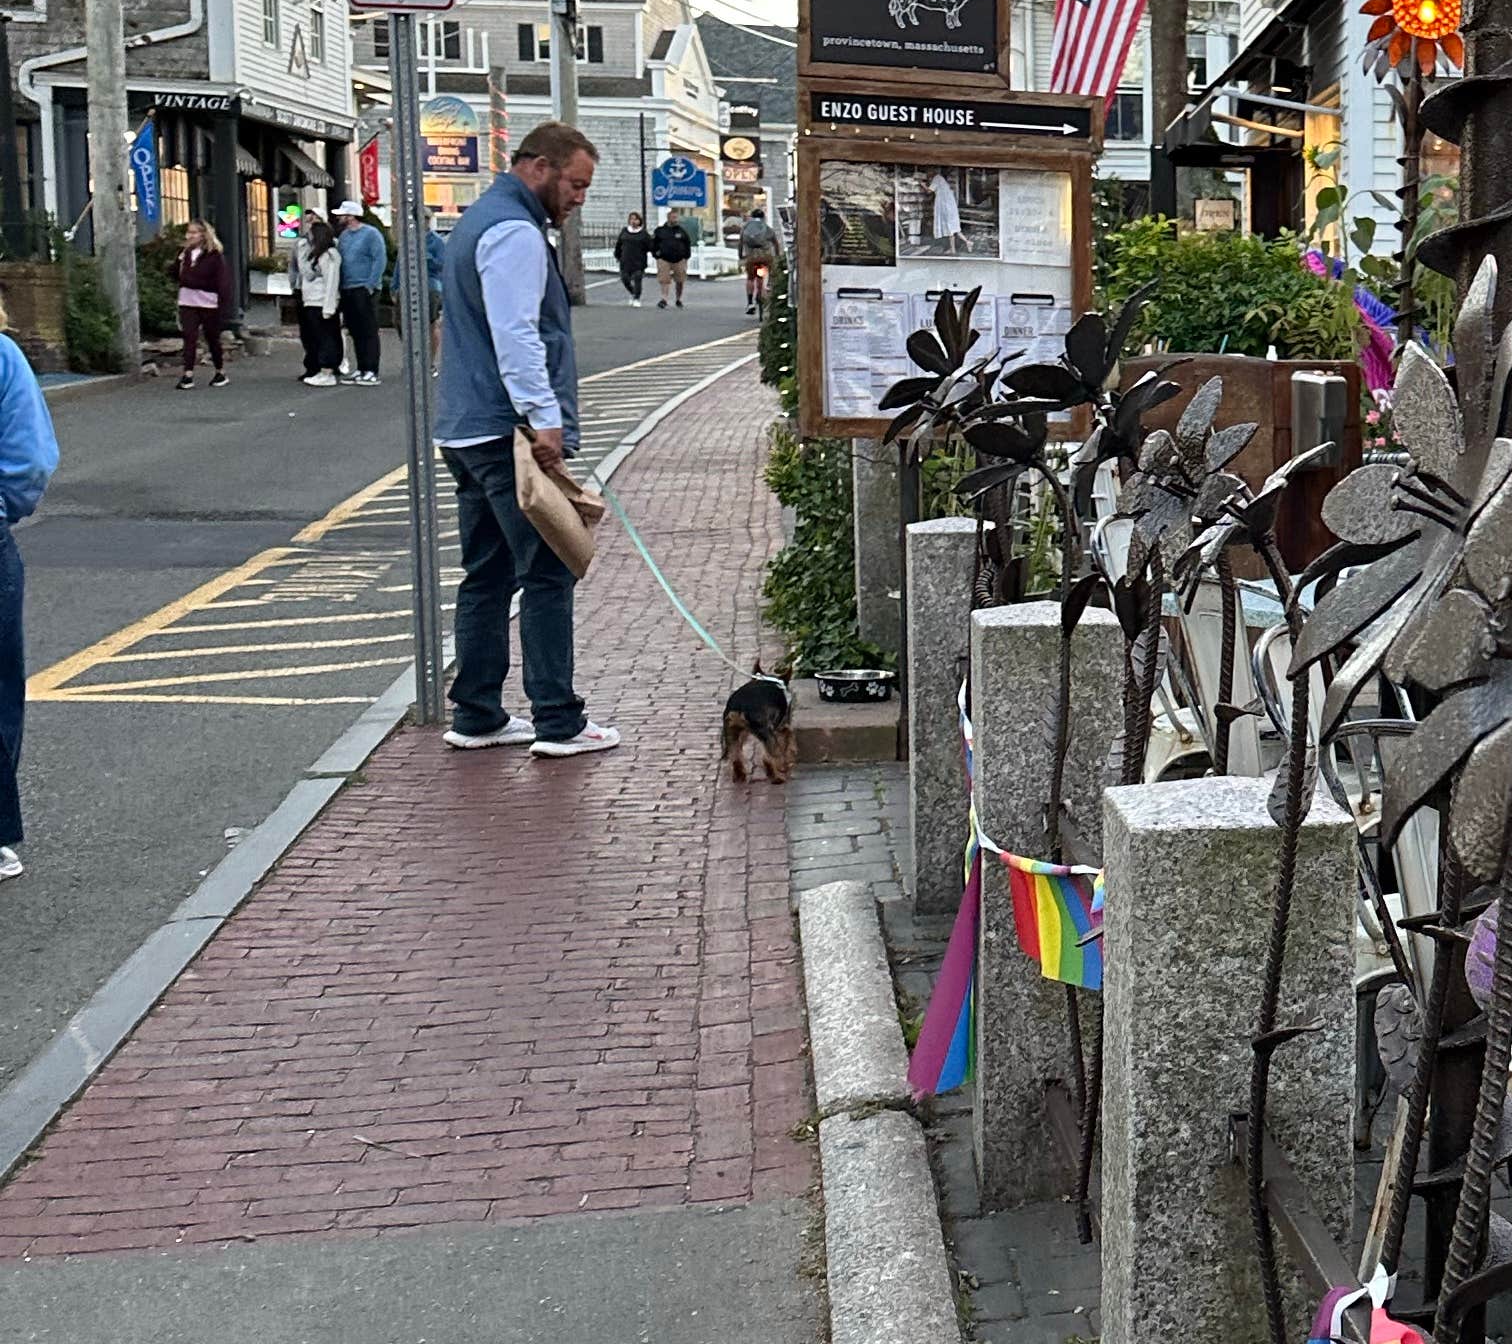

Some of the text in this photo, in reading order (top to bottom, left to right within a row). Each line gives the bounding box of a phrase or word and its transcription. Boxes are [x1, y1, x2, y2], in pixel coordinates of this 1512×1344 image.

[823, 34, 985, 55] provincetown, massachusetts
[153, 94, 232, 111] VINTAGE
[821, 101, 975, 125] ENZO GUEST HOUSE
[1003, 326, 1034, 337] DINNER
